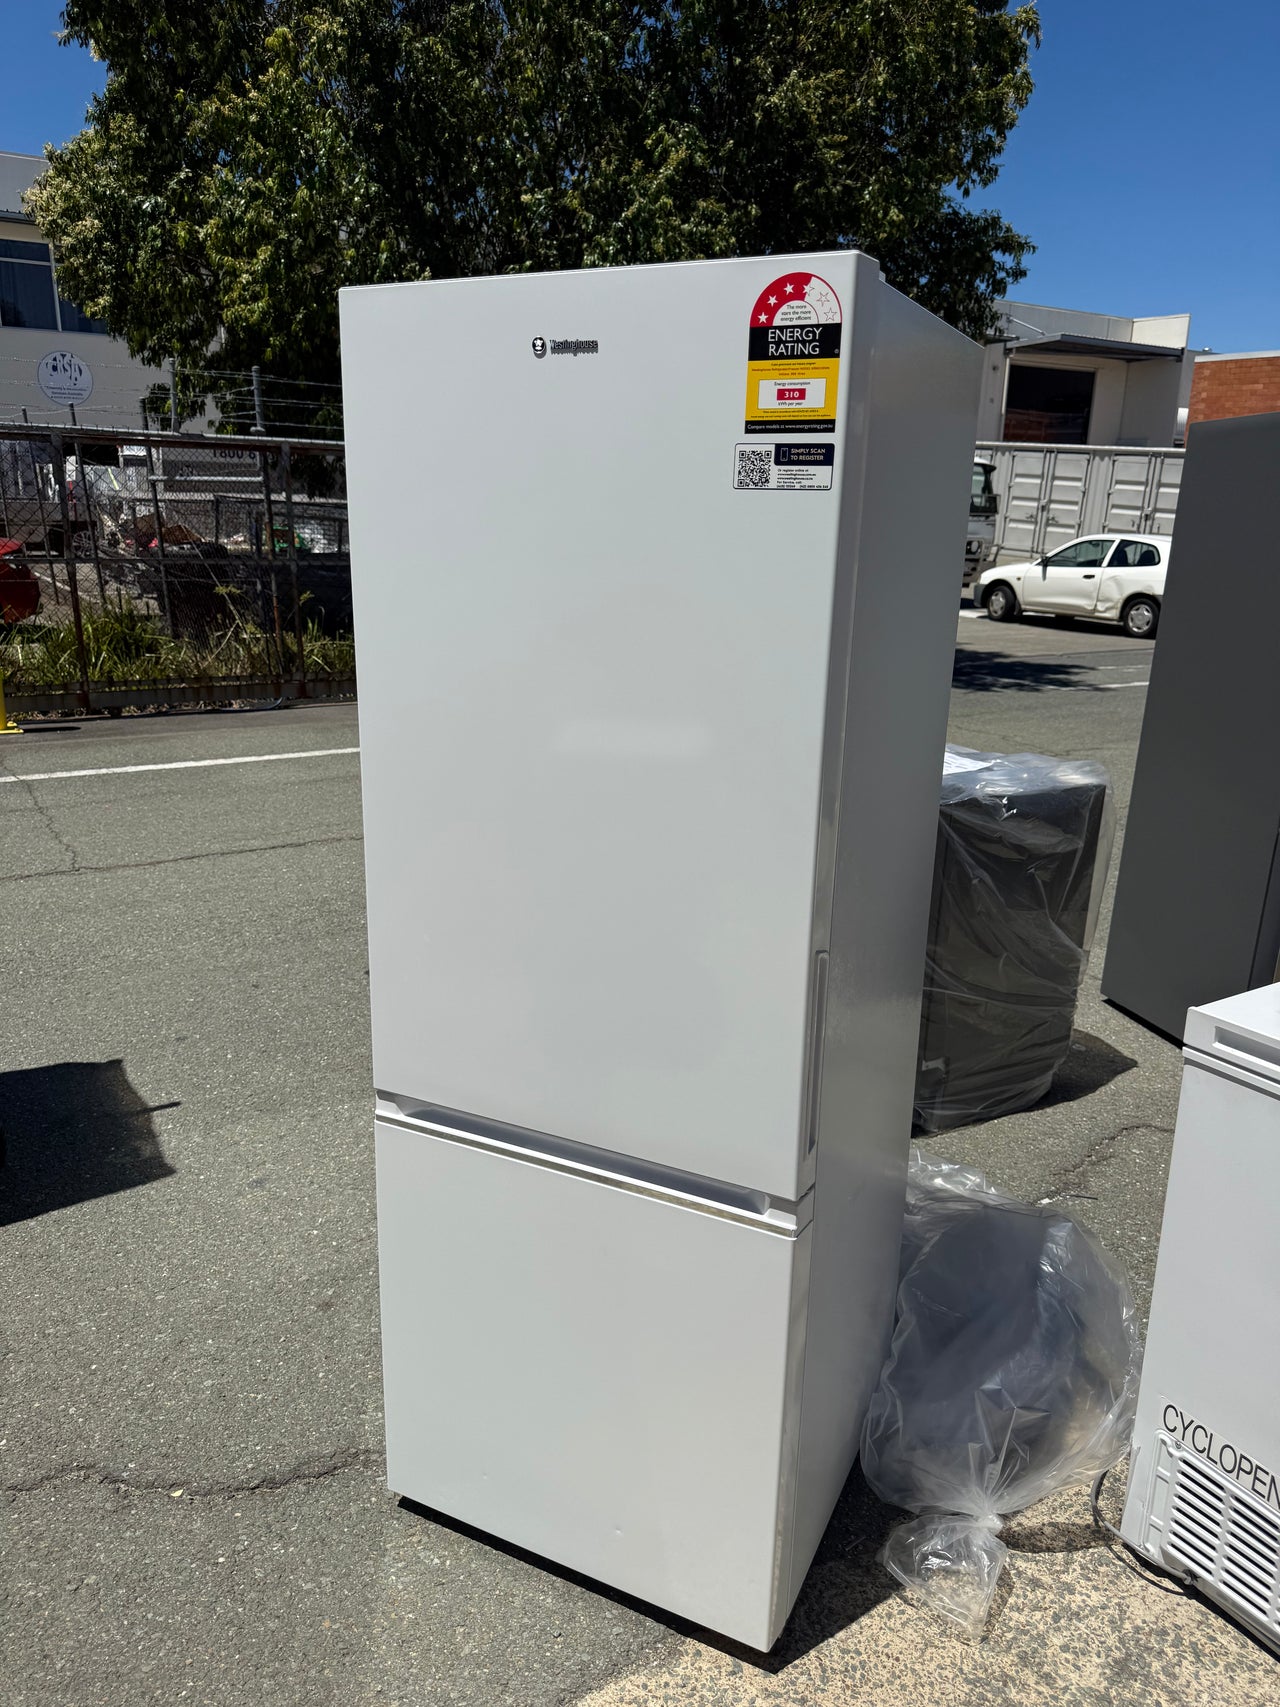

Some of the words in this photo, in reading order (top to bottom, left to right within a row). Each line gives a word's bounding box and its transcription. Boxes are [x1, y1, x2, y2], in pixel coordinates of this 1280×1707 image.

[768, 327, 822, 342] ENERGY
[768, 342, 819, 356] RATING
[1164, 1404, 1280, 1509] CYCLOPEN
